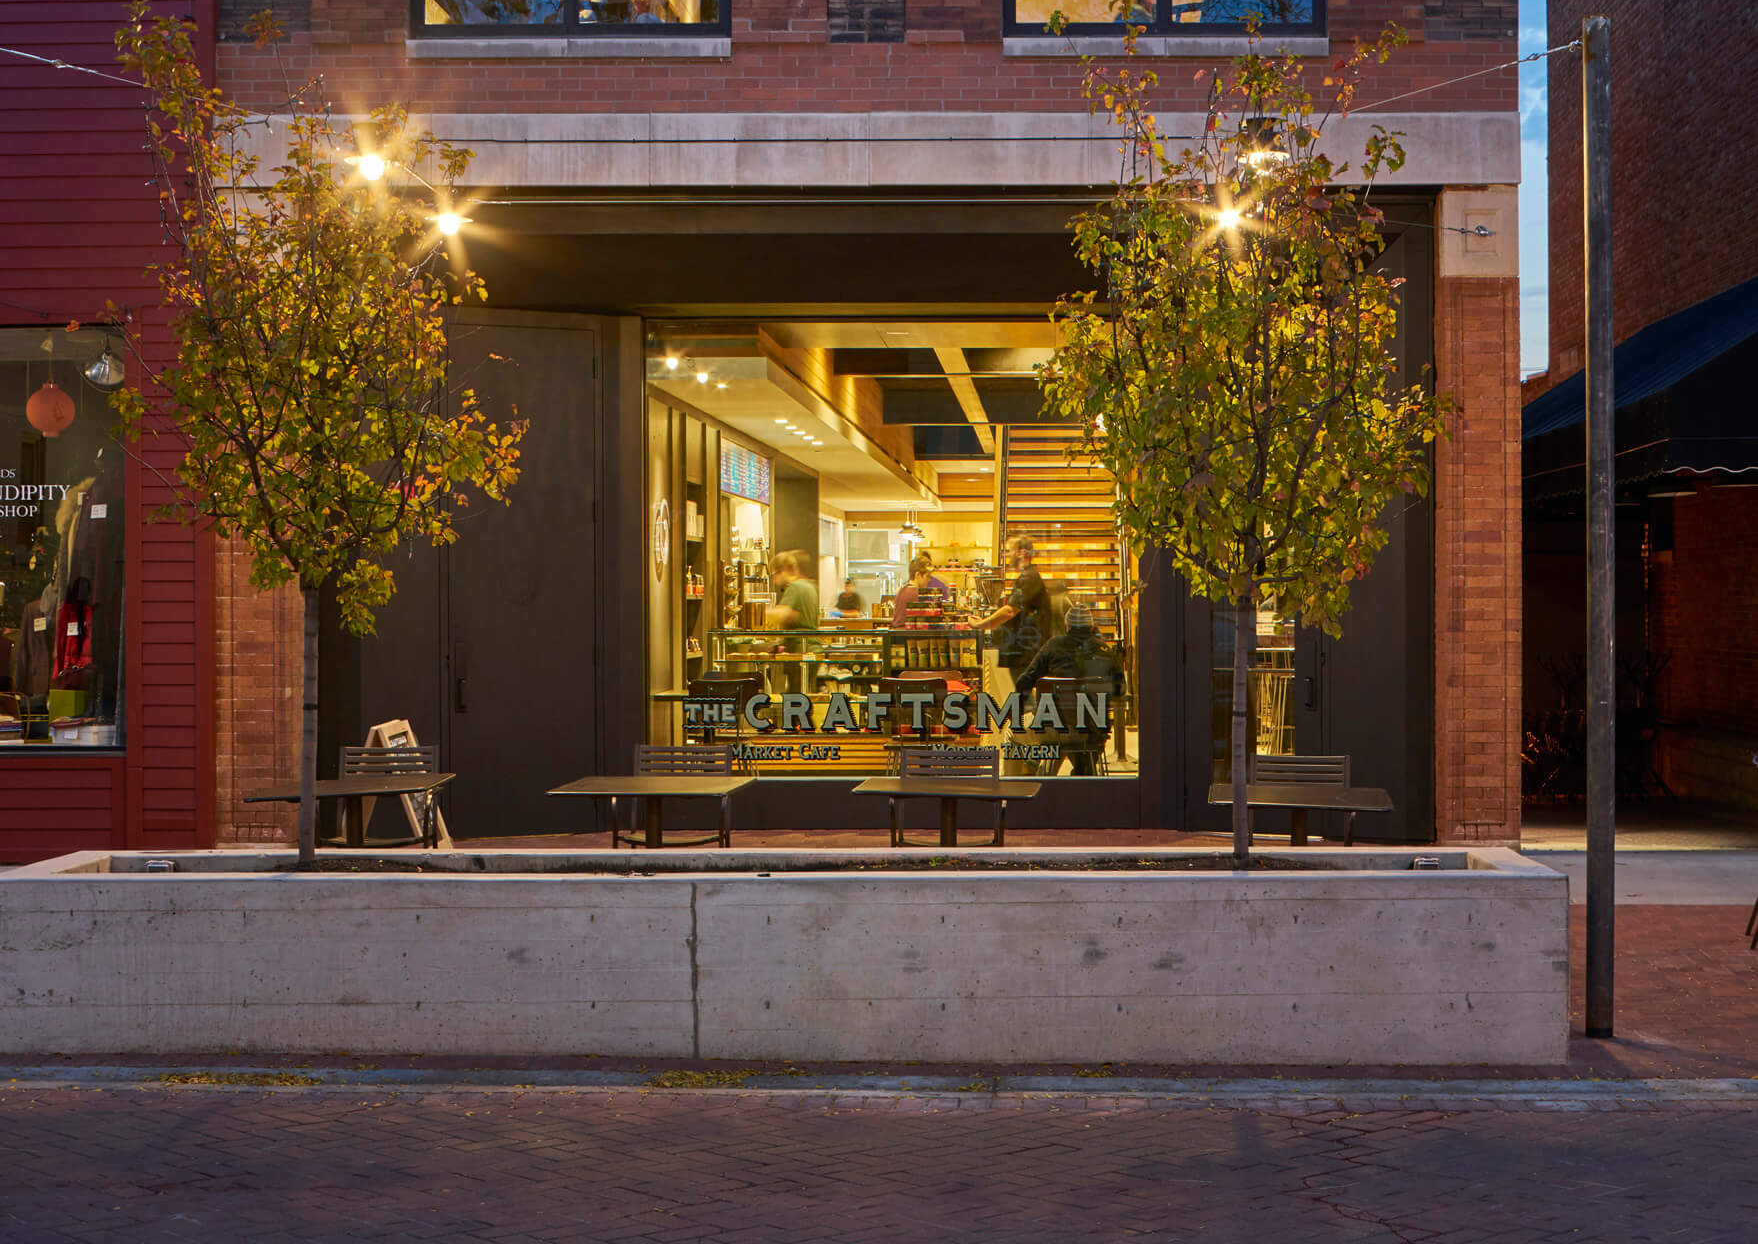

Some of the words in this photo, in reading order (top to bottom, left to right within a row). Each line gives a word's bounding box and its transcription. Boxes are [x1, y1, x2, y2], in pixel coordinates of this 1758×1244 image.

[0, 484, 70, 500] DIPITY
[684, 702, 736, 724] THE
[743, 691, 1109, 731] CRAFTSMAN
[728, 743, 793, 760] MARKET
[798, 743, 841, 760] CAFE
[1001, 742, 1060, 760] TAVERN
